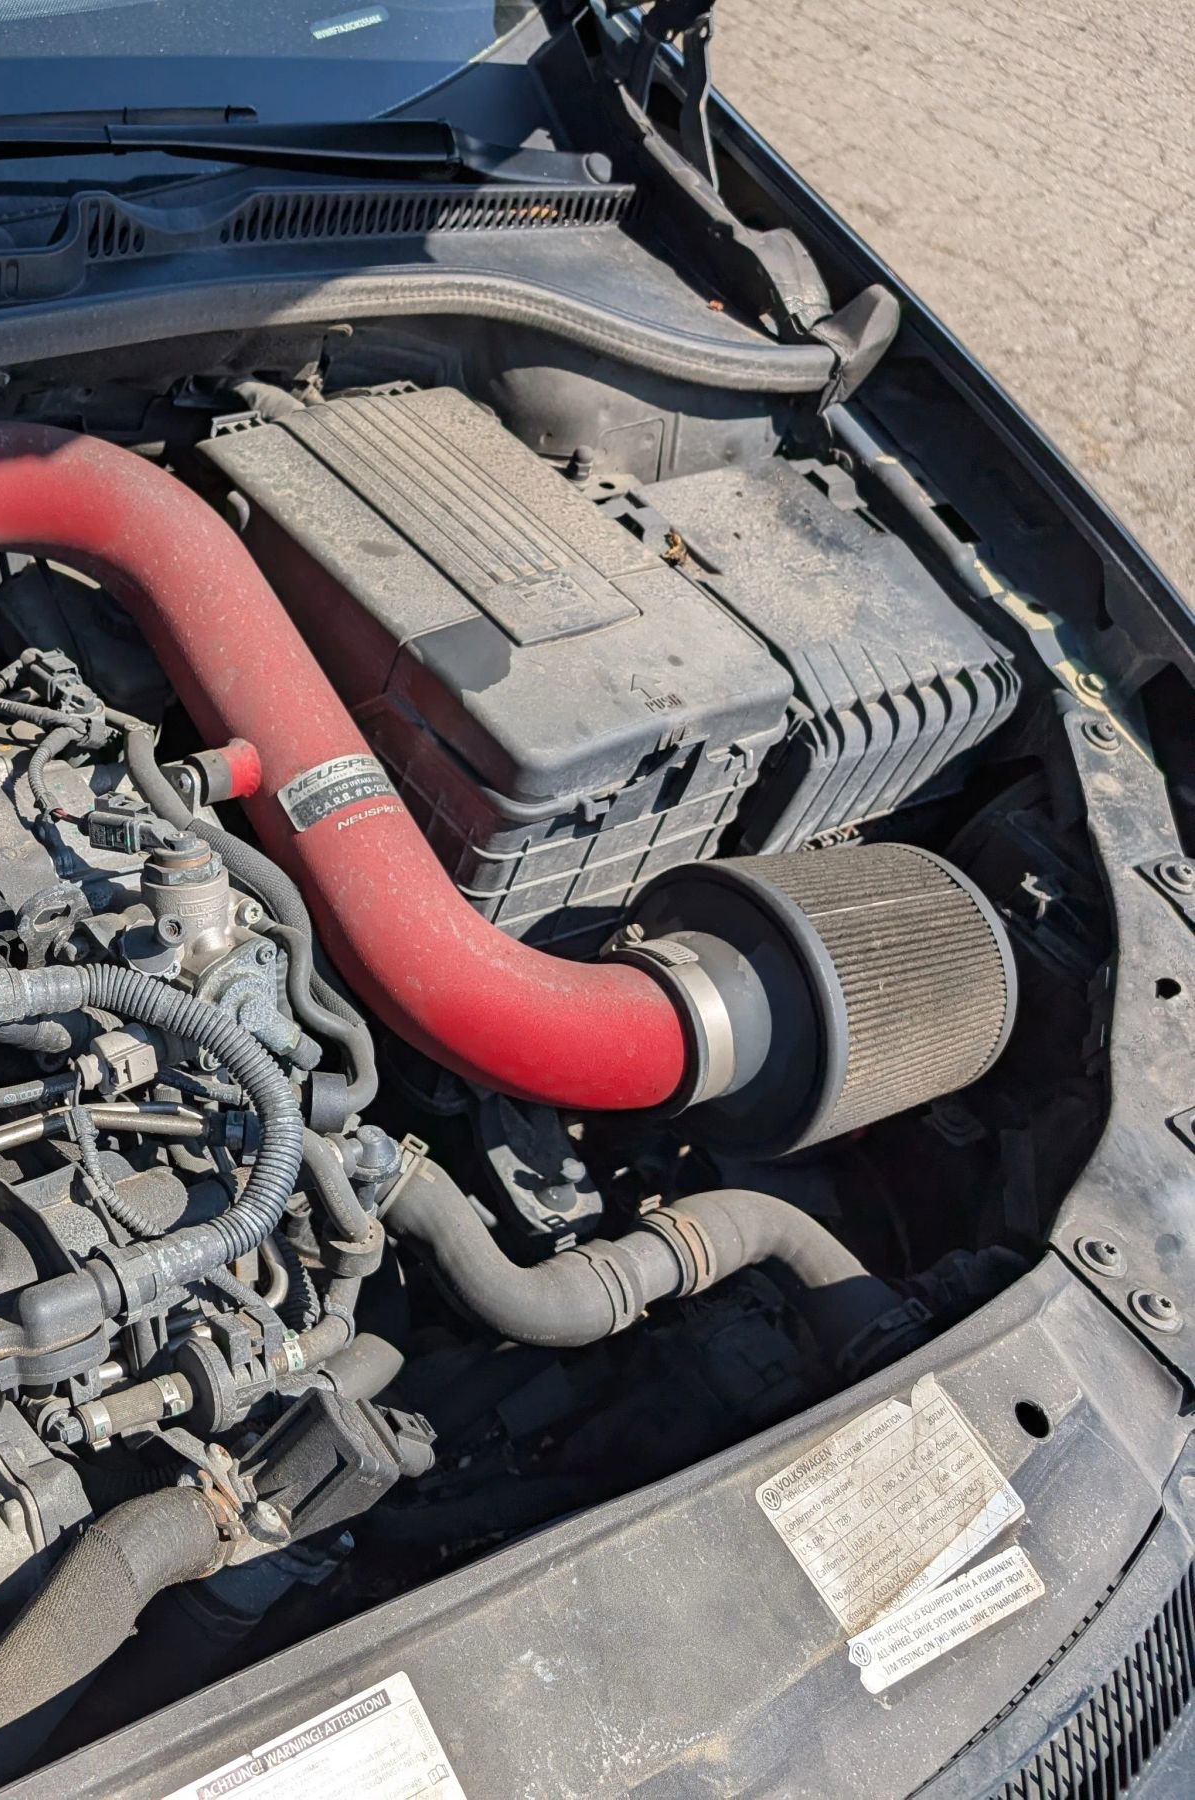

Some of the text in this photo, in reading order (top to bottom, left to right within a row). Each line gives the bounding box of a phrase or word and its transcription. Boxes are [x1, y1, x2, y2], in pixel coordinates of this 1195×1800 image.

[287, 757, 374, 799] NEUSPE
[315, 793, 354, 815] C.A.R.B.
[774, 1445, 833, 1492] VOLKSWAGEN
[782, 1411, 903, 1502] VEHICLE EMISSION CONTROL INFORMATION
[948, 1450, 975, 1473] Gasoline
[782, 1505, 816, 1533] Conforms
[811, 1501, 822, 1512] to
[830, 1589, 843, 1602] No
[838, 1561, 881, 1597] adjustments
[867, 1630, 886, 1646] THIS
[883, 1614, 914, 1637] VEHICLE
[911, 1610, 921, 1621] IS
[919, 1591, 954, 1617] EQUIPPED
[952, 1580, 972, 1598] WITH
[970, 1577, 979, 1587] A
[976, 1555, 1016, 1584] PERMANENT
[874, 1568, 1025, 1661] ALL-WHEEL DRIVE SYSTEM AND IS EXEMPT FROM
[896, 1646, 925, 1668] TESTING
[922, 1639, 936, 1653] ON
[933, 1618, 971, 1647] TWO-WHEEL
[968, 1607, 990, 1626] DRIVE
[986, 1580, 1036, 1615] DYNAMOMETERS.
[201, 1758, 263, 1800] ACHTUNG!
[261, 1725, 325, 1768] WARNING!
[320, 1691, 388, 1736] ATTENTION!
